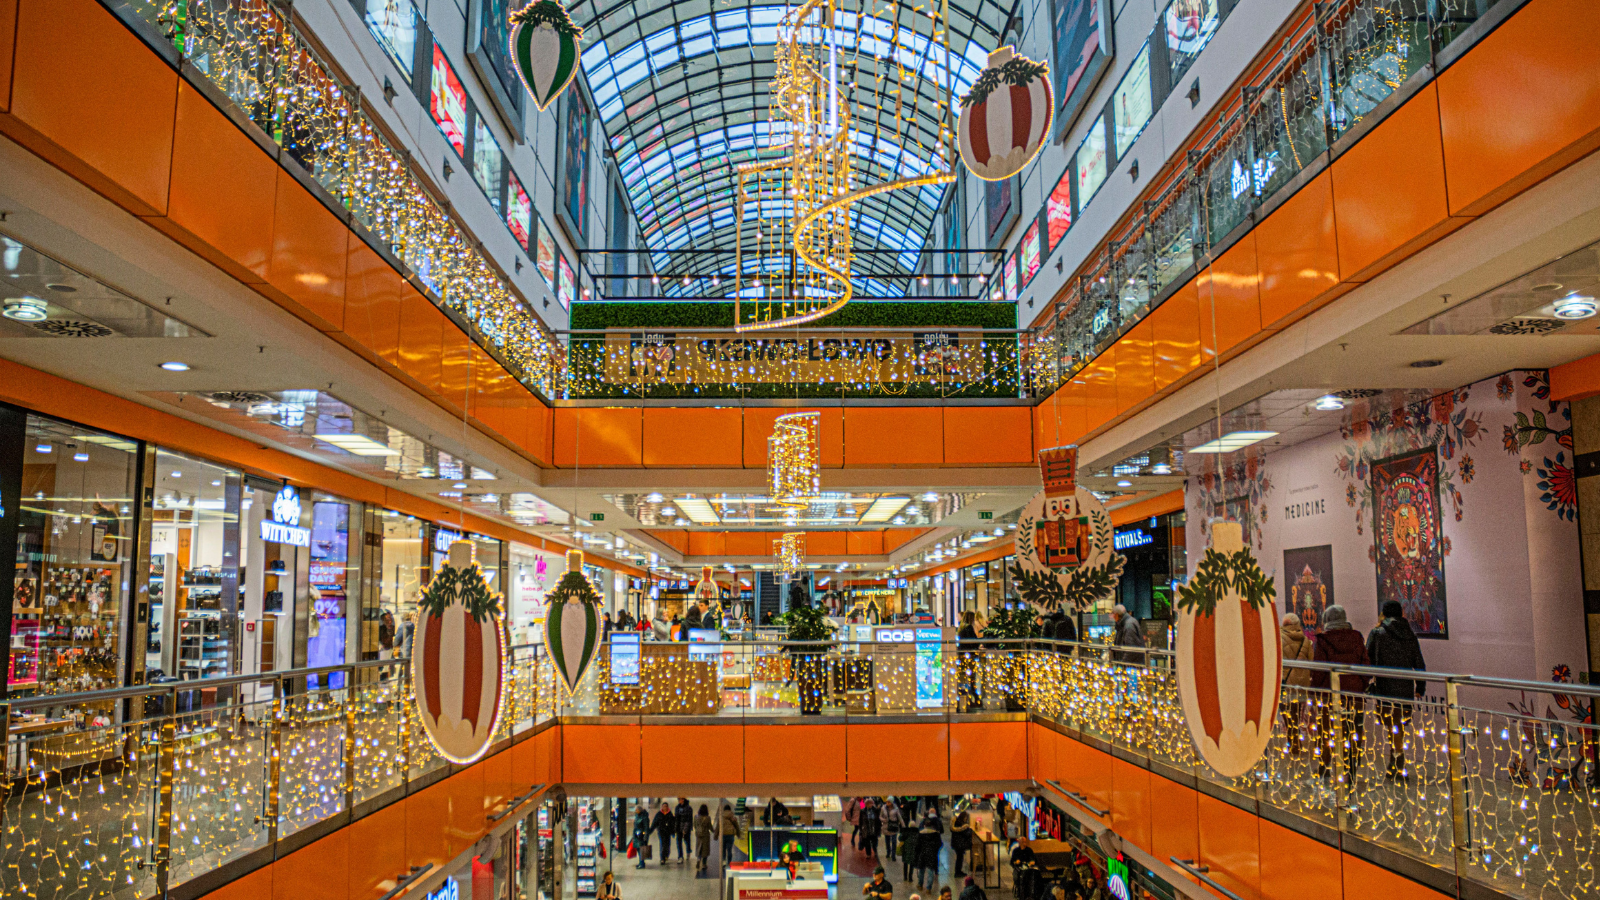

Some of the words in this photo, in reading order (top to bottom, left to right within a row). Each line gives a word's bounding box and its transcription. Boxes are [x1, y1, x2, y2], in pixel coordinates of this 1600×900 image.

[1285, 499, 1325, 520] MEDICINE
[261, 520, 310, 547] WITTCHEN
[309, 574, 335, 583] DAYS
[875, 630, 915, 642] IQOS
[745, 890, 783, 899] Millennium
